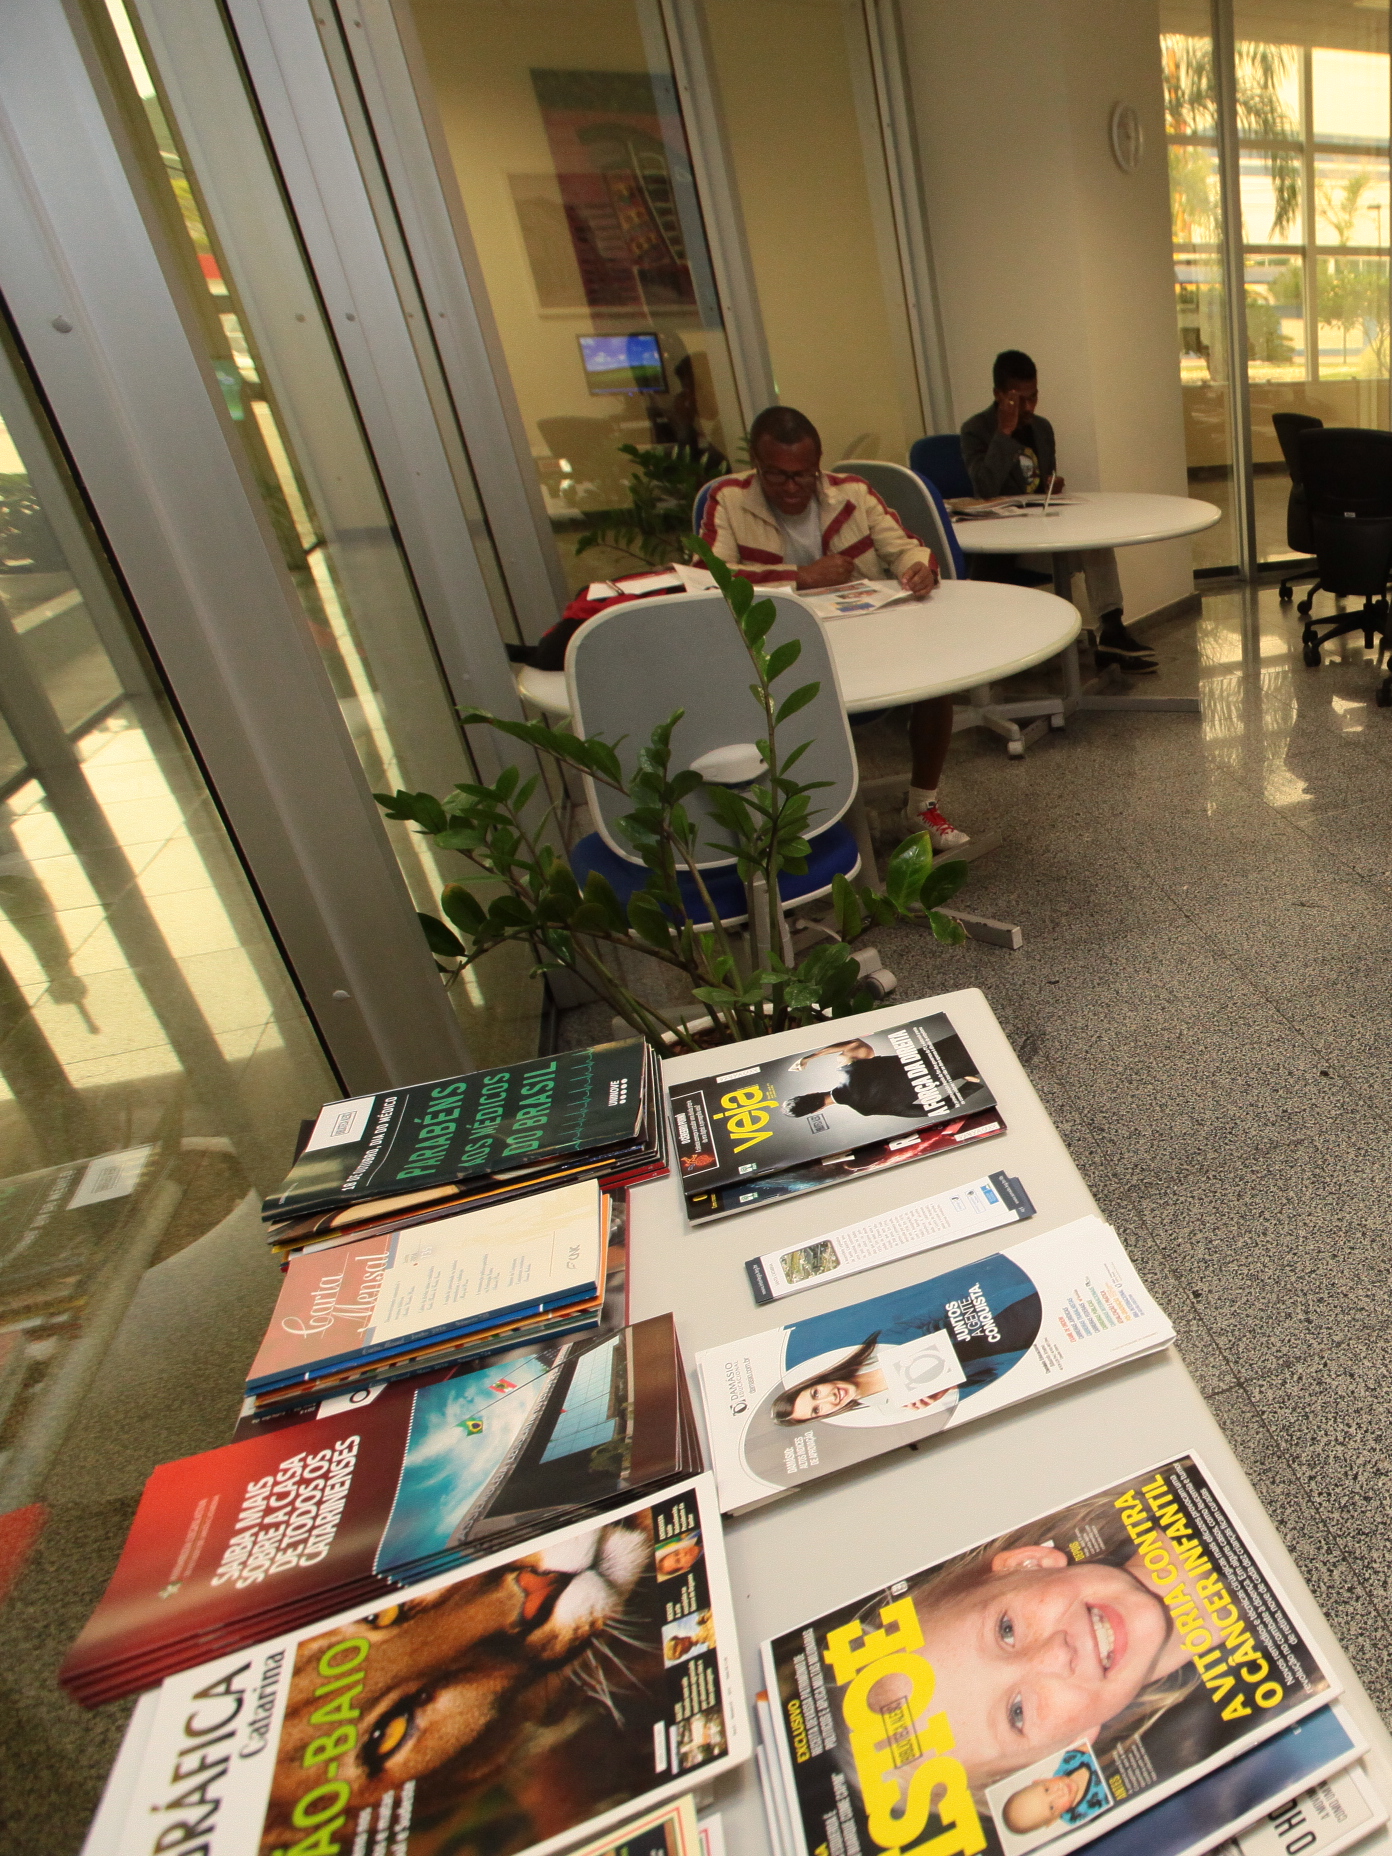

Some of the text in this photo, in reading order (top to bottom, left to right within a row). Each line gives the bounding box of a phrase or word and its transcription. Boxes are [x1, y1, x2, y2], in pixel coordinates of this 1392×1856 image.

[888, 1030, 950, 1118] A FORÇA DA DIREITA
[377, 1096, 397, 1123] MÉDICO
[458, 1073, 509, 1166] AOS MÉDICOS
[502, 1062, 556, 1156] DO BRASIL
[713, 1084, 779, 1154] veja
[369, 1133, 385, 1146] DIA
[374, 1123, 388, 1134] DO
[397, 1083, 466, 1178] PARABÉNS
[282, 1272, 344, 1337] Carta
[327, 1251, 389, 1332] Mensal
[946, 1301, 970, 1341] JUNTOS
[958, 1296, 986, 1336] A GENTE
[968, 1283, 1000, 1342] CONQUISTA.
[724, 1362, 738, 1401] DAMÁSIO
[269, 1452, 306, 1507] CASA
[1170, 1475, 1181, 1488] uma
[1172, 1462, 1186, 1480] tumor
[299, 1436, 359, 1566] CATARINENSES
[1178, 1488, 1199, 1518] provocam
[1186, 1482, 1204, 1510] leucemia
[1200, 1488, 1217, 1512] curadas
[263, 1506, 292, 1524] A
[268, 1450, 332, 1574] DE TODOS OS
[1201, 1508, 1215, 1526] como
[1214, 1511, 1228, 1529] ficam
[210, 1476, 273, 1586] SAIBA MAIS
[1194, 1517, 1212, 1542] eficazes
[1212, 1525, 1226, 1546] casos,
[1224, 1528, 1244, 1554] crianças
[236, 1524, 285, 1588] SOBRE
[1069, 1541, 1084, 1561] DEPOIS
[1209, 1542, 1222, 1558] mais
[1223, 1545, 1239, 1567] alguns
[1240, 1554, 1251, 1567] dez
[1218, 1557, 1240, 1590] cirúrgicas
[1236, 1566, 1246, 1580] Em
[1247, 1566, 1261, 1584] cada
[1115, 1490, 1252, 1720] A VITÓRIA CONTRA
[1142, 1475, 1283, 1708] O CÂNCER INFANTIL
[1237, 1590, 1257, 1620] técnicas
[1243, 1578, 1262, 1606] doença.
[1263, 1593, 1277, 1611] nove
[1262, 1612, 1284, 1644] combate
[1274, 1610, 1291, 1634] retina,
[1256, 1624, 1280, 1659] remédios
[1276, 1658, 1294, 1685] Novos
[1287, 1654, 1314, 1695] revolução
[239, 1649, 286, 1760] Catarina
[788, 1700, 815, 1762] EXCLUSIVO
[823, 1596, 988, 1856] ISTOÉ
[1329, 1800, 1347, 1818] COMO
[1286, 1831, 1316, 1855] O
